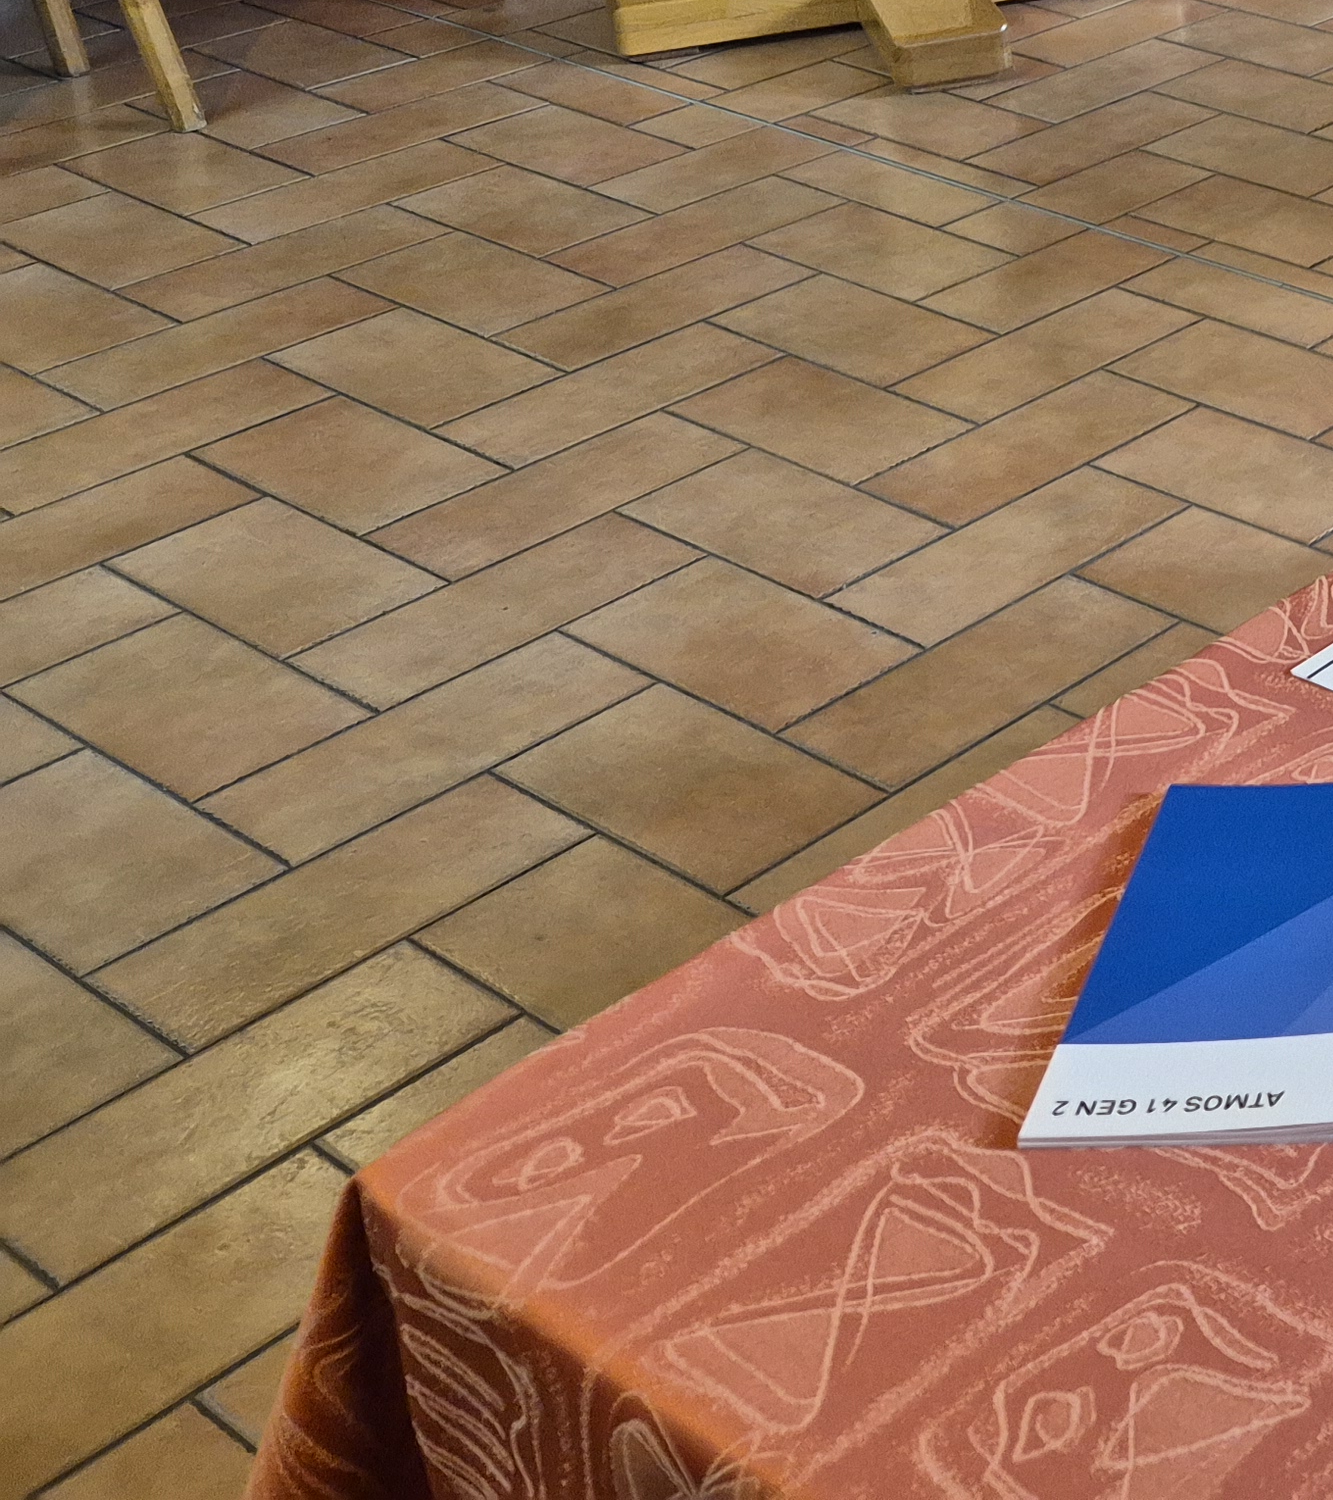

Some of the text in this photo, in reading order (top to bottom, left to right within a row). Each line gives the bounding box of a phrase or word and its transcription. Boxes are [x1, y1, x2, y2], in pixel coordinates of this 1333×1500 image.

[1051, 1089, 1286, 1118] ATMOS 41 GEN 2
